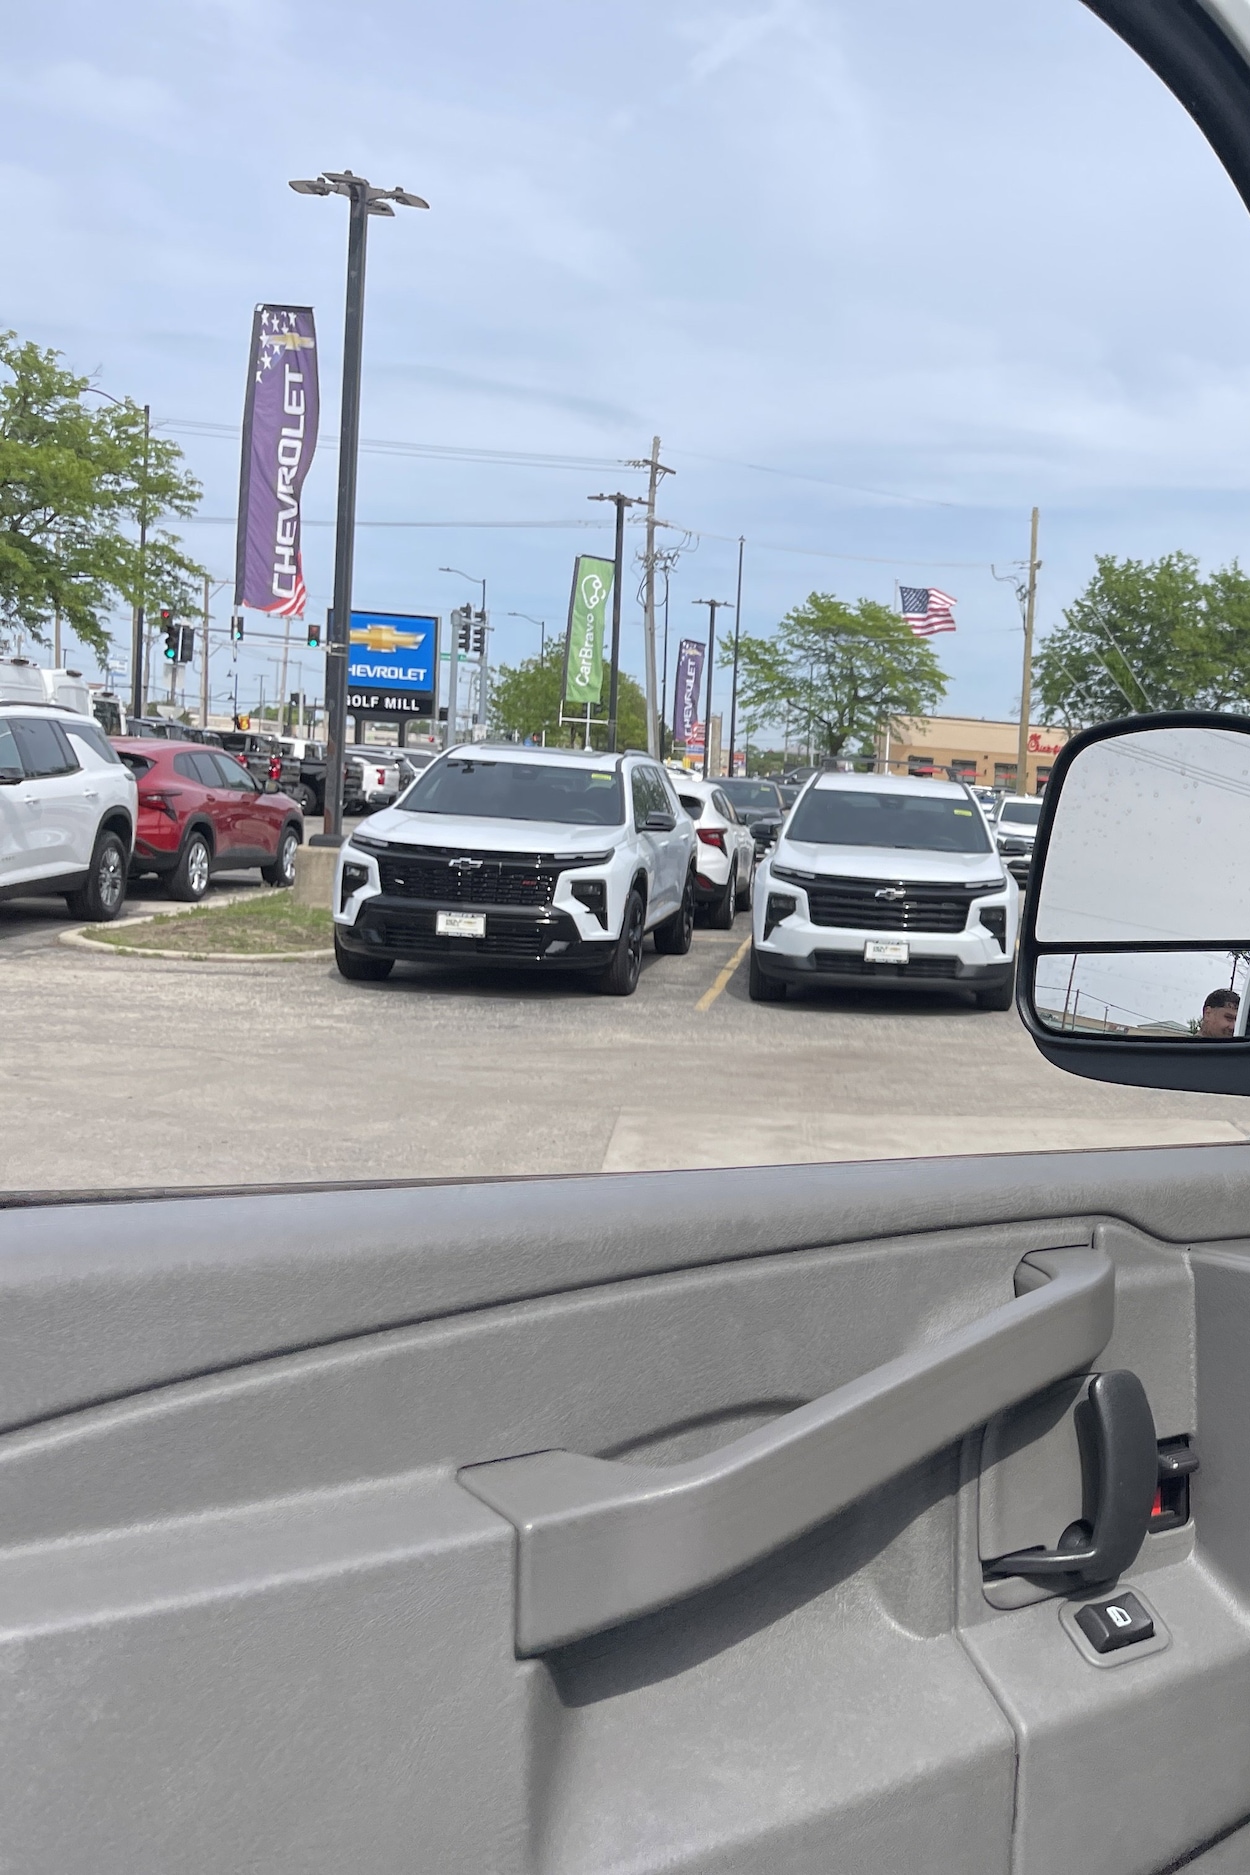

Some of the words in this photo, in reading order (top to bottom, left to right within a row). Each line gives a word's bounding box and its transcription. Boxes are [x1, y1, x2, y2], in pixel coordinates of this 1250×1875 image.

[272, 363, 305, 598] CHEVROLET
[348, 663, 427, 682] HEVROLET
[575, 613, 595, 686] CarBravo
[384, 697, 420, 712] MILL
[684, 658, 696, 737] CHEVROLET
